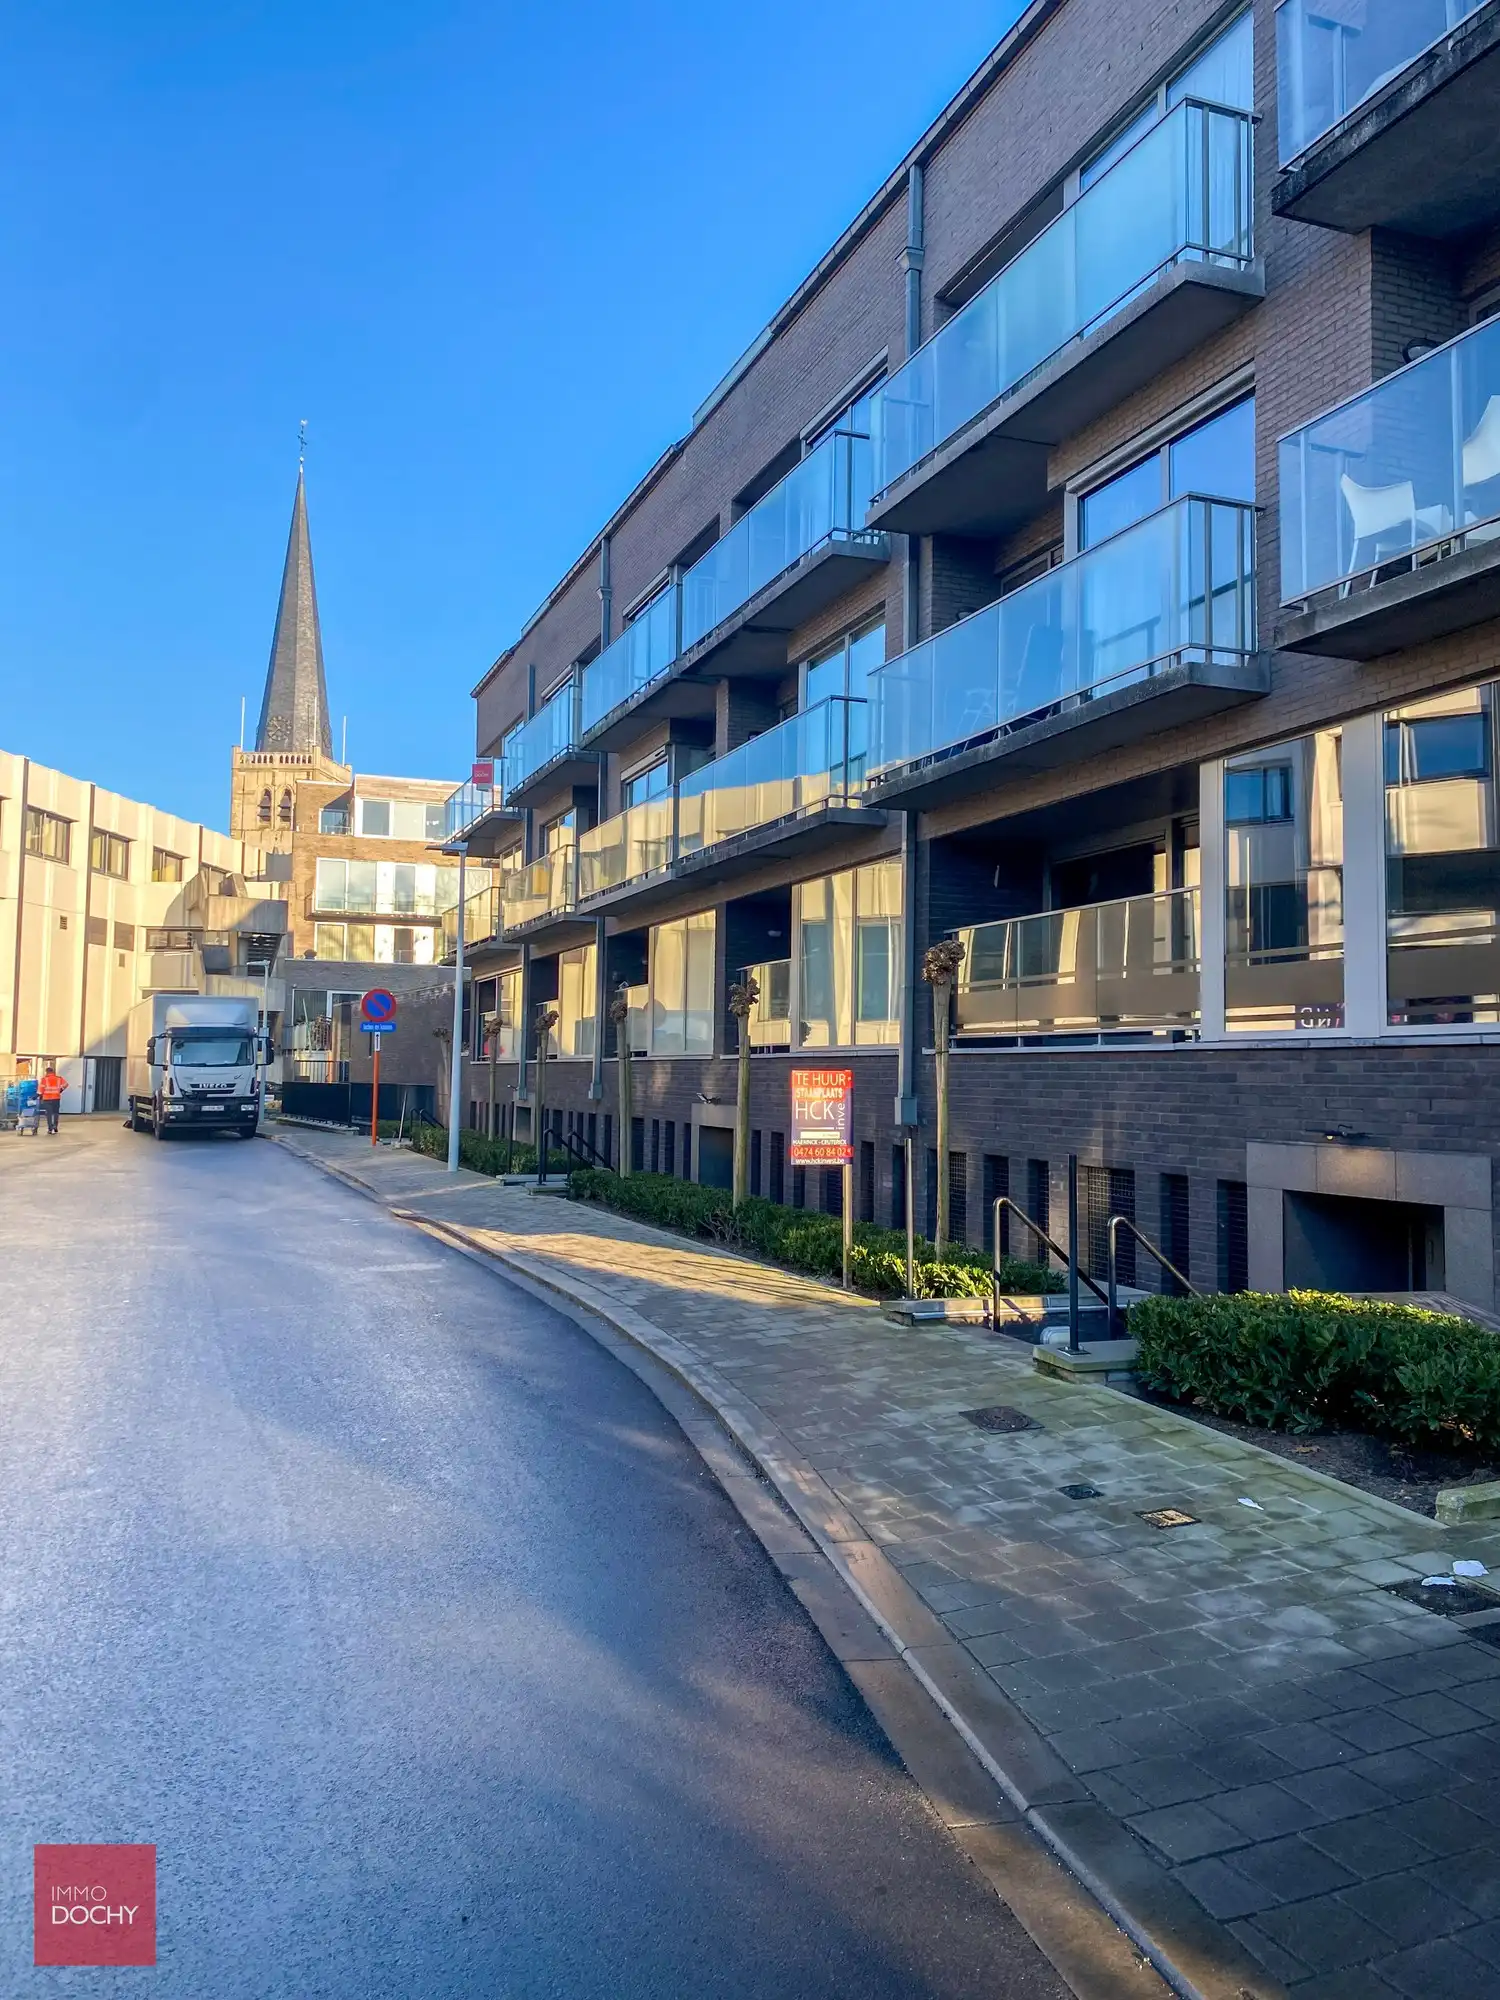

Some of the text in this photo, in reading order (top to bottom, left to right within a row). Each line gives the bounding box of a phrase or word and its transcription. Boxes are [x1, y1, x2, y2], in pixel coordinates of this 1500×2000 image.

[795, 1073, 846, 1086] TE HUUR
[795, 1101, 835, 1120] HCK
[836, 1103, 845, 1130] inve
[794, 1147, 813, 1156] 0474
[814, 1147, 825, 1156] 60
[826, 1147, 836, 1156] 84
